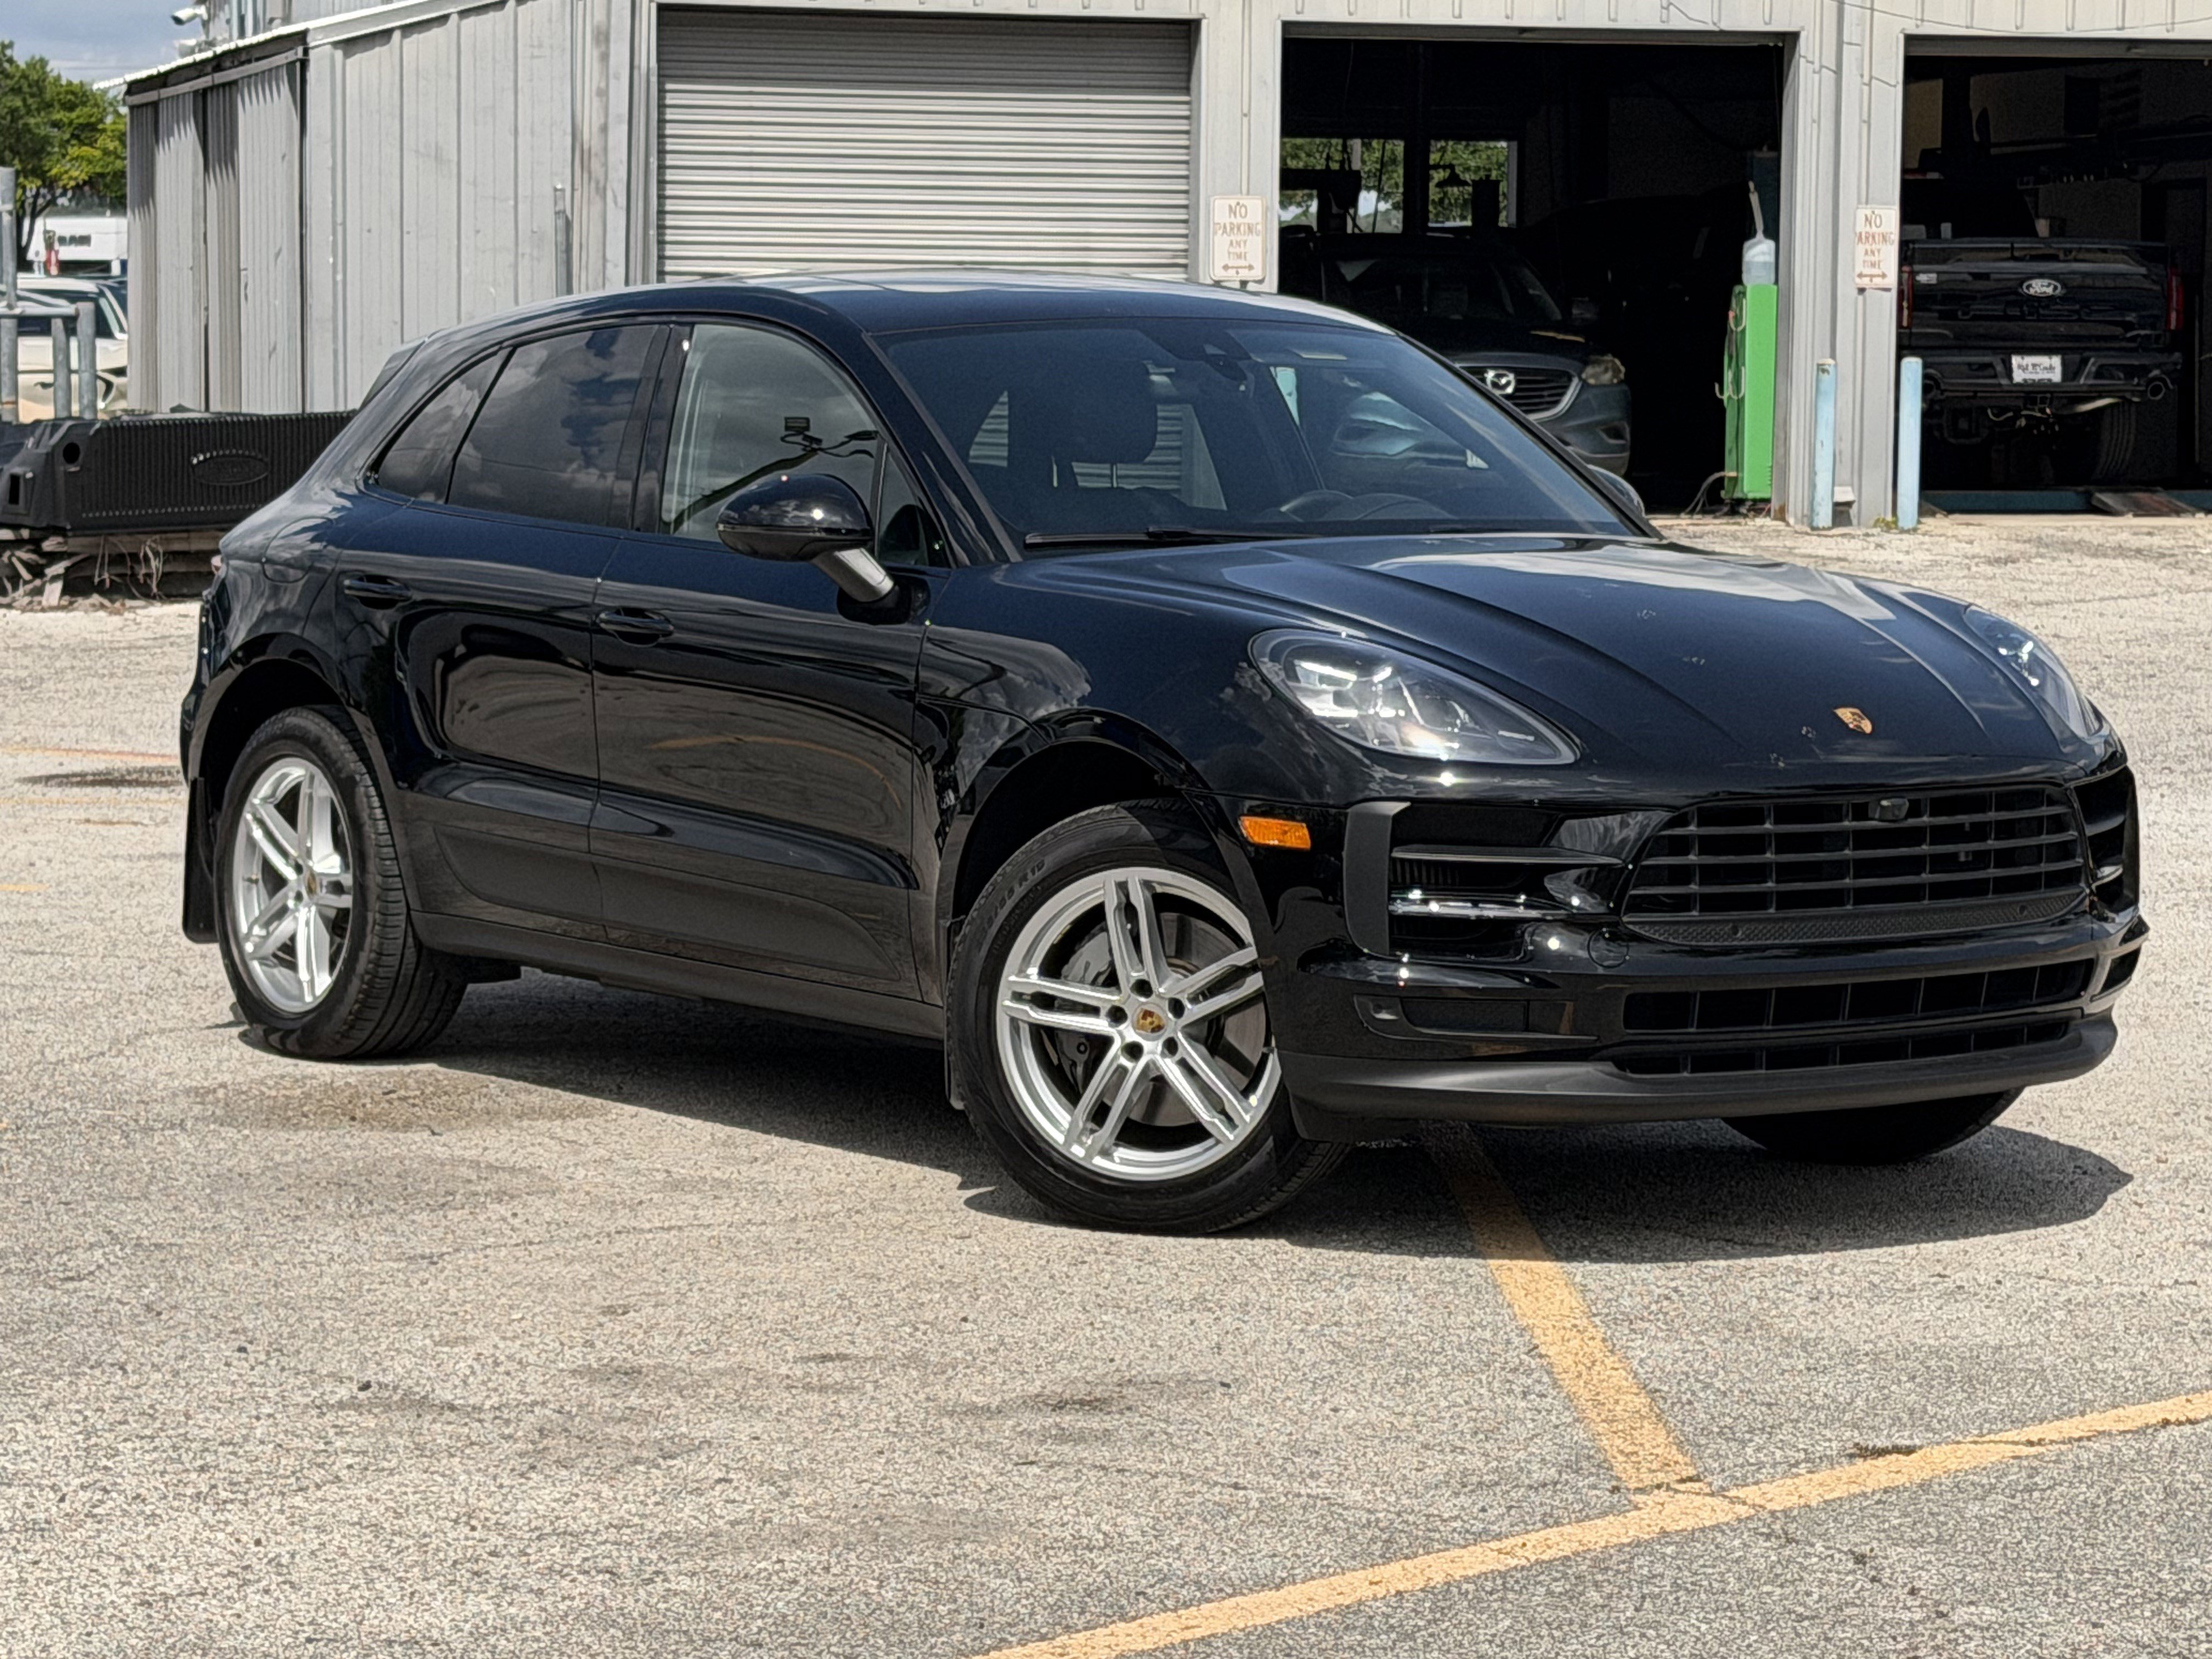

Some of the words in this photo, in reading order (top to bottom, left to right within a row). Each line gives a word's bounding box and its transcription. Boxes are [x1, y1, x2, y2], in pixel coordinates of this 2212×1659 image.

[1228, 203, 1248, 219] NO
[1864, 213, 1883, 229] NO
[1214, 221, 1261, 237] PARKING
[1228, 239, 1248, 249] ANY
[1855, 231, 1895, 246] ARKING
[1227, 251, 1248, 262] TIME
[1864, 248, 1882, 257] ANY
